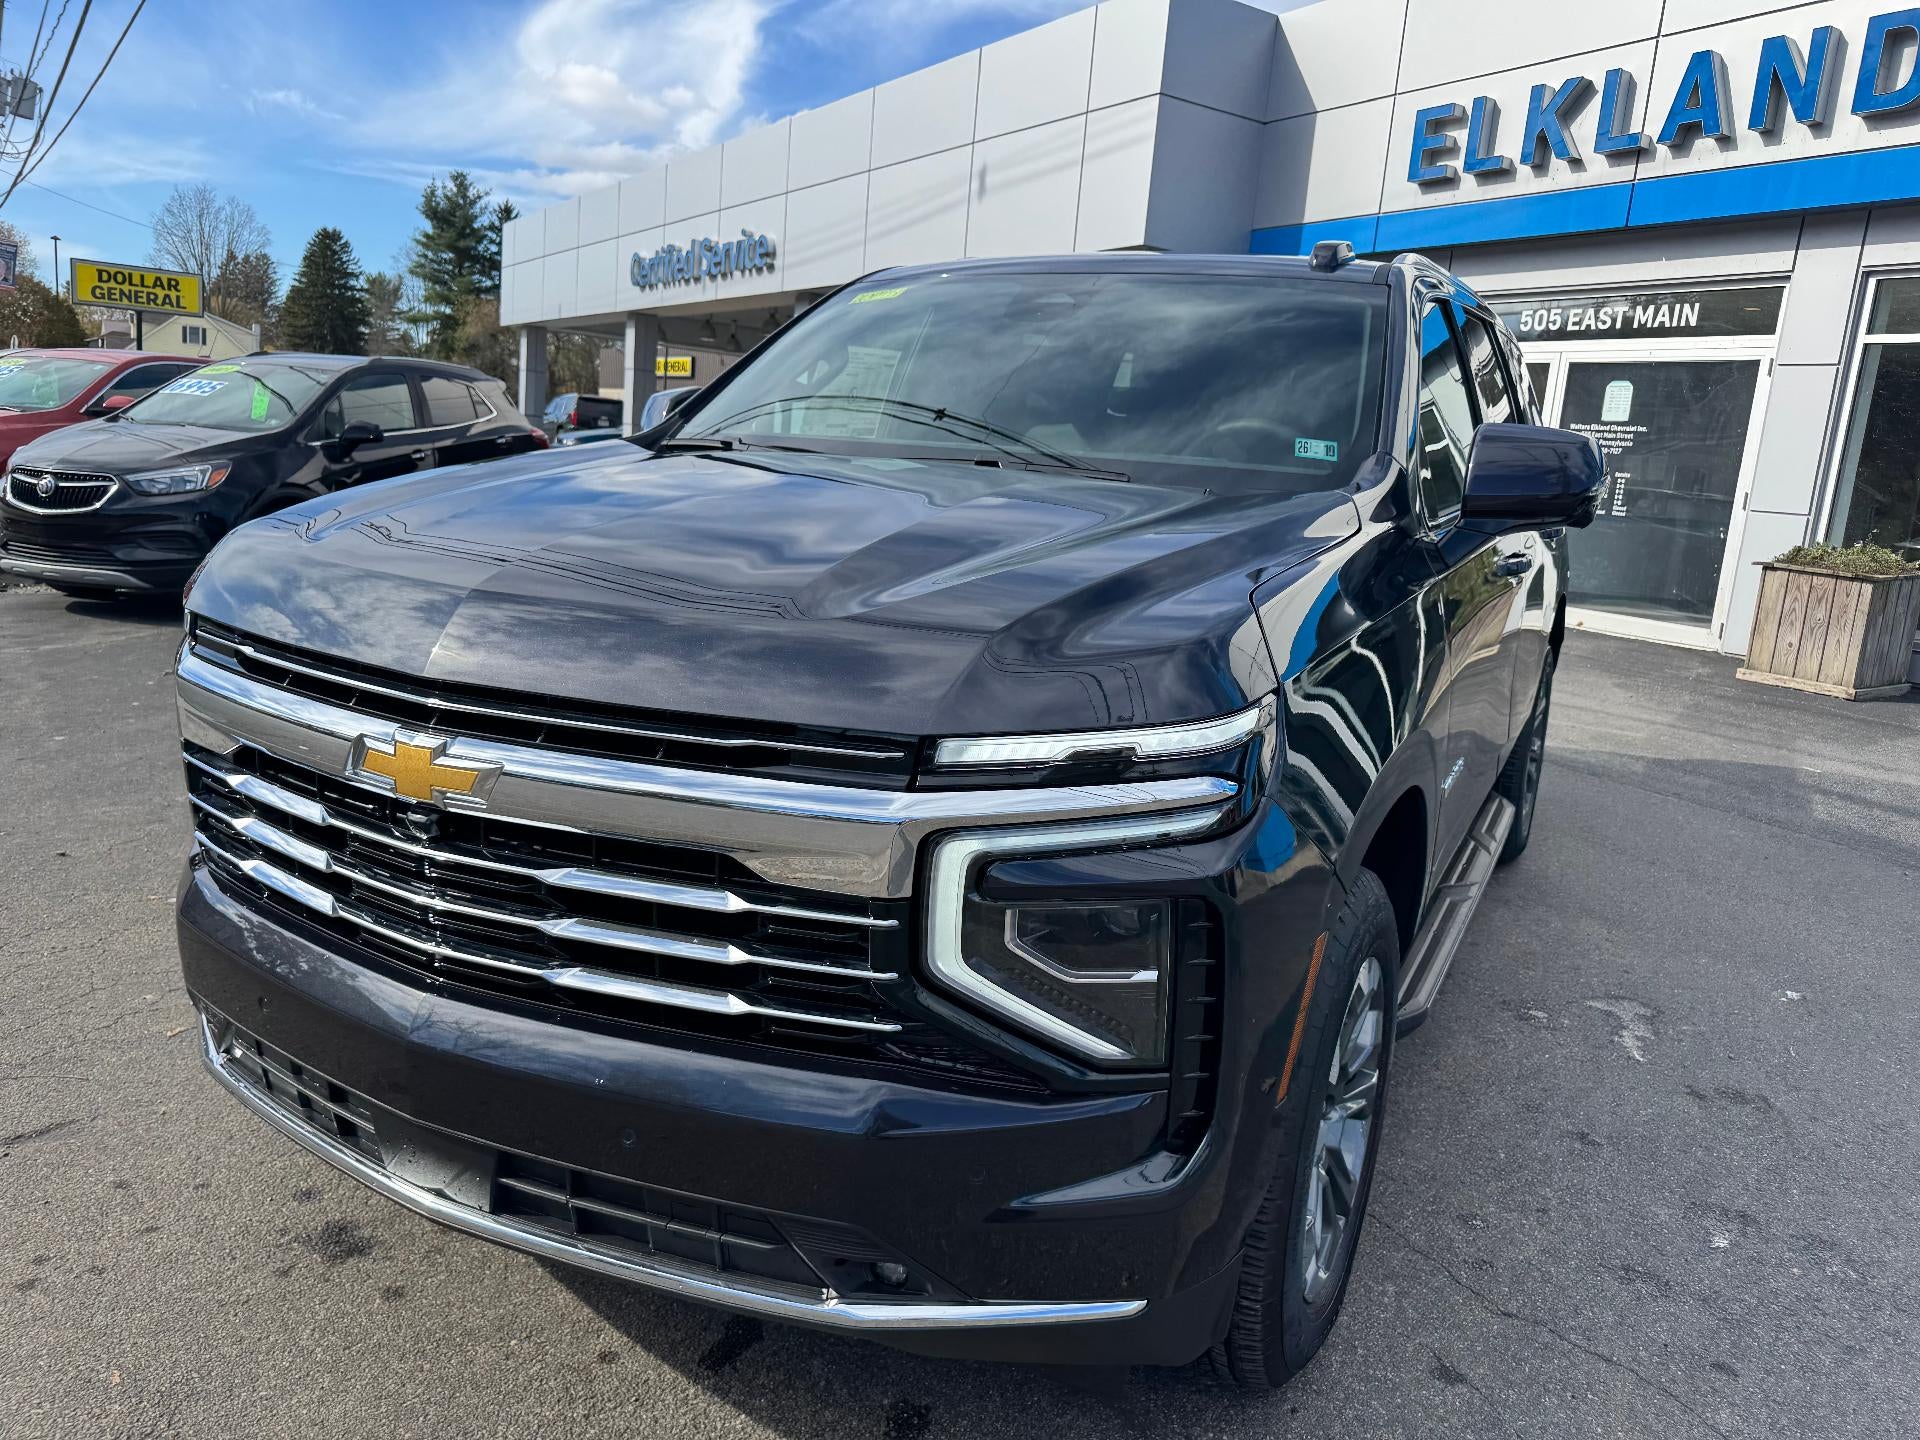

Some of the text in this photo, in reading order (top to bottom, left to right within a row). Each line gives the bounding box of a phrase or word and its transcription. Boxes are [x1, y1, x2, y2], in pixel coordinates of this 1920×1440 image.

[1407, 8, 1920, 184] ELKLAND
[631, 228, 770, 287] Certified Service
[95, 268, 181, 293] DOLLAR
[91, 285, 187, 310] GENERAL
[1519, 302, 1700, 332] 505 EAST MAIN
[1298, 440, 1309, 454] 26
